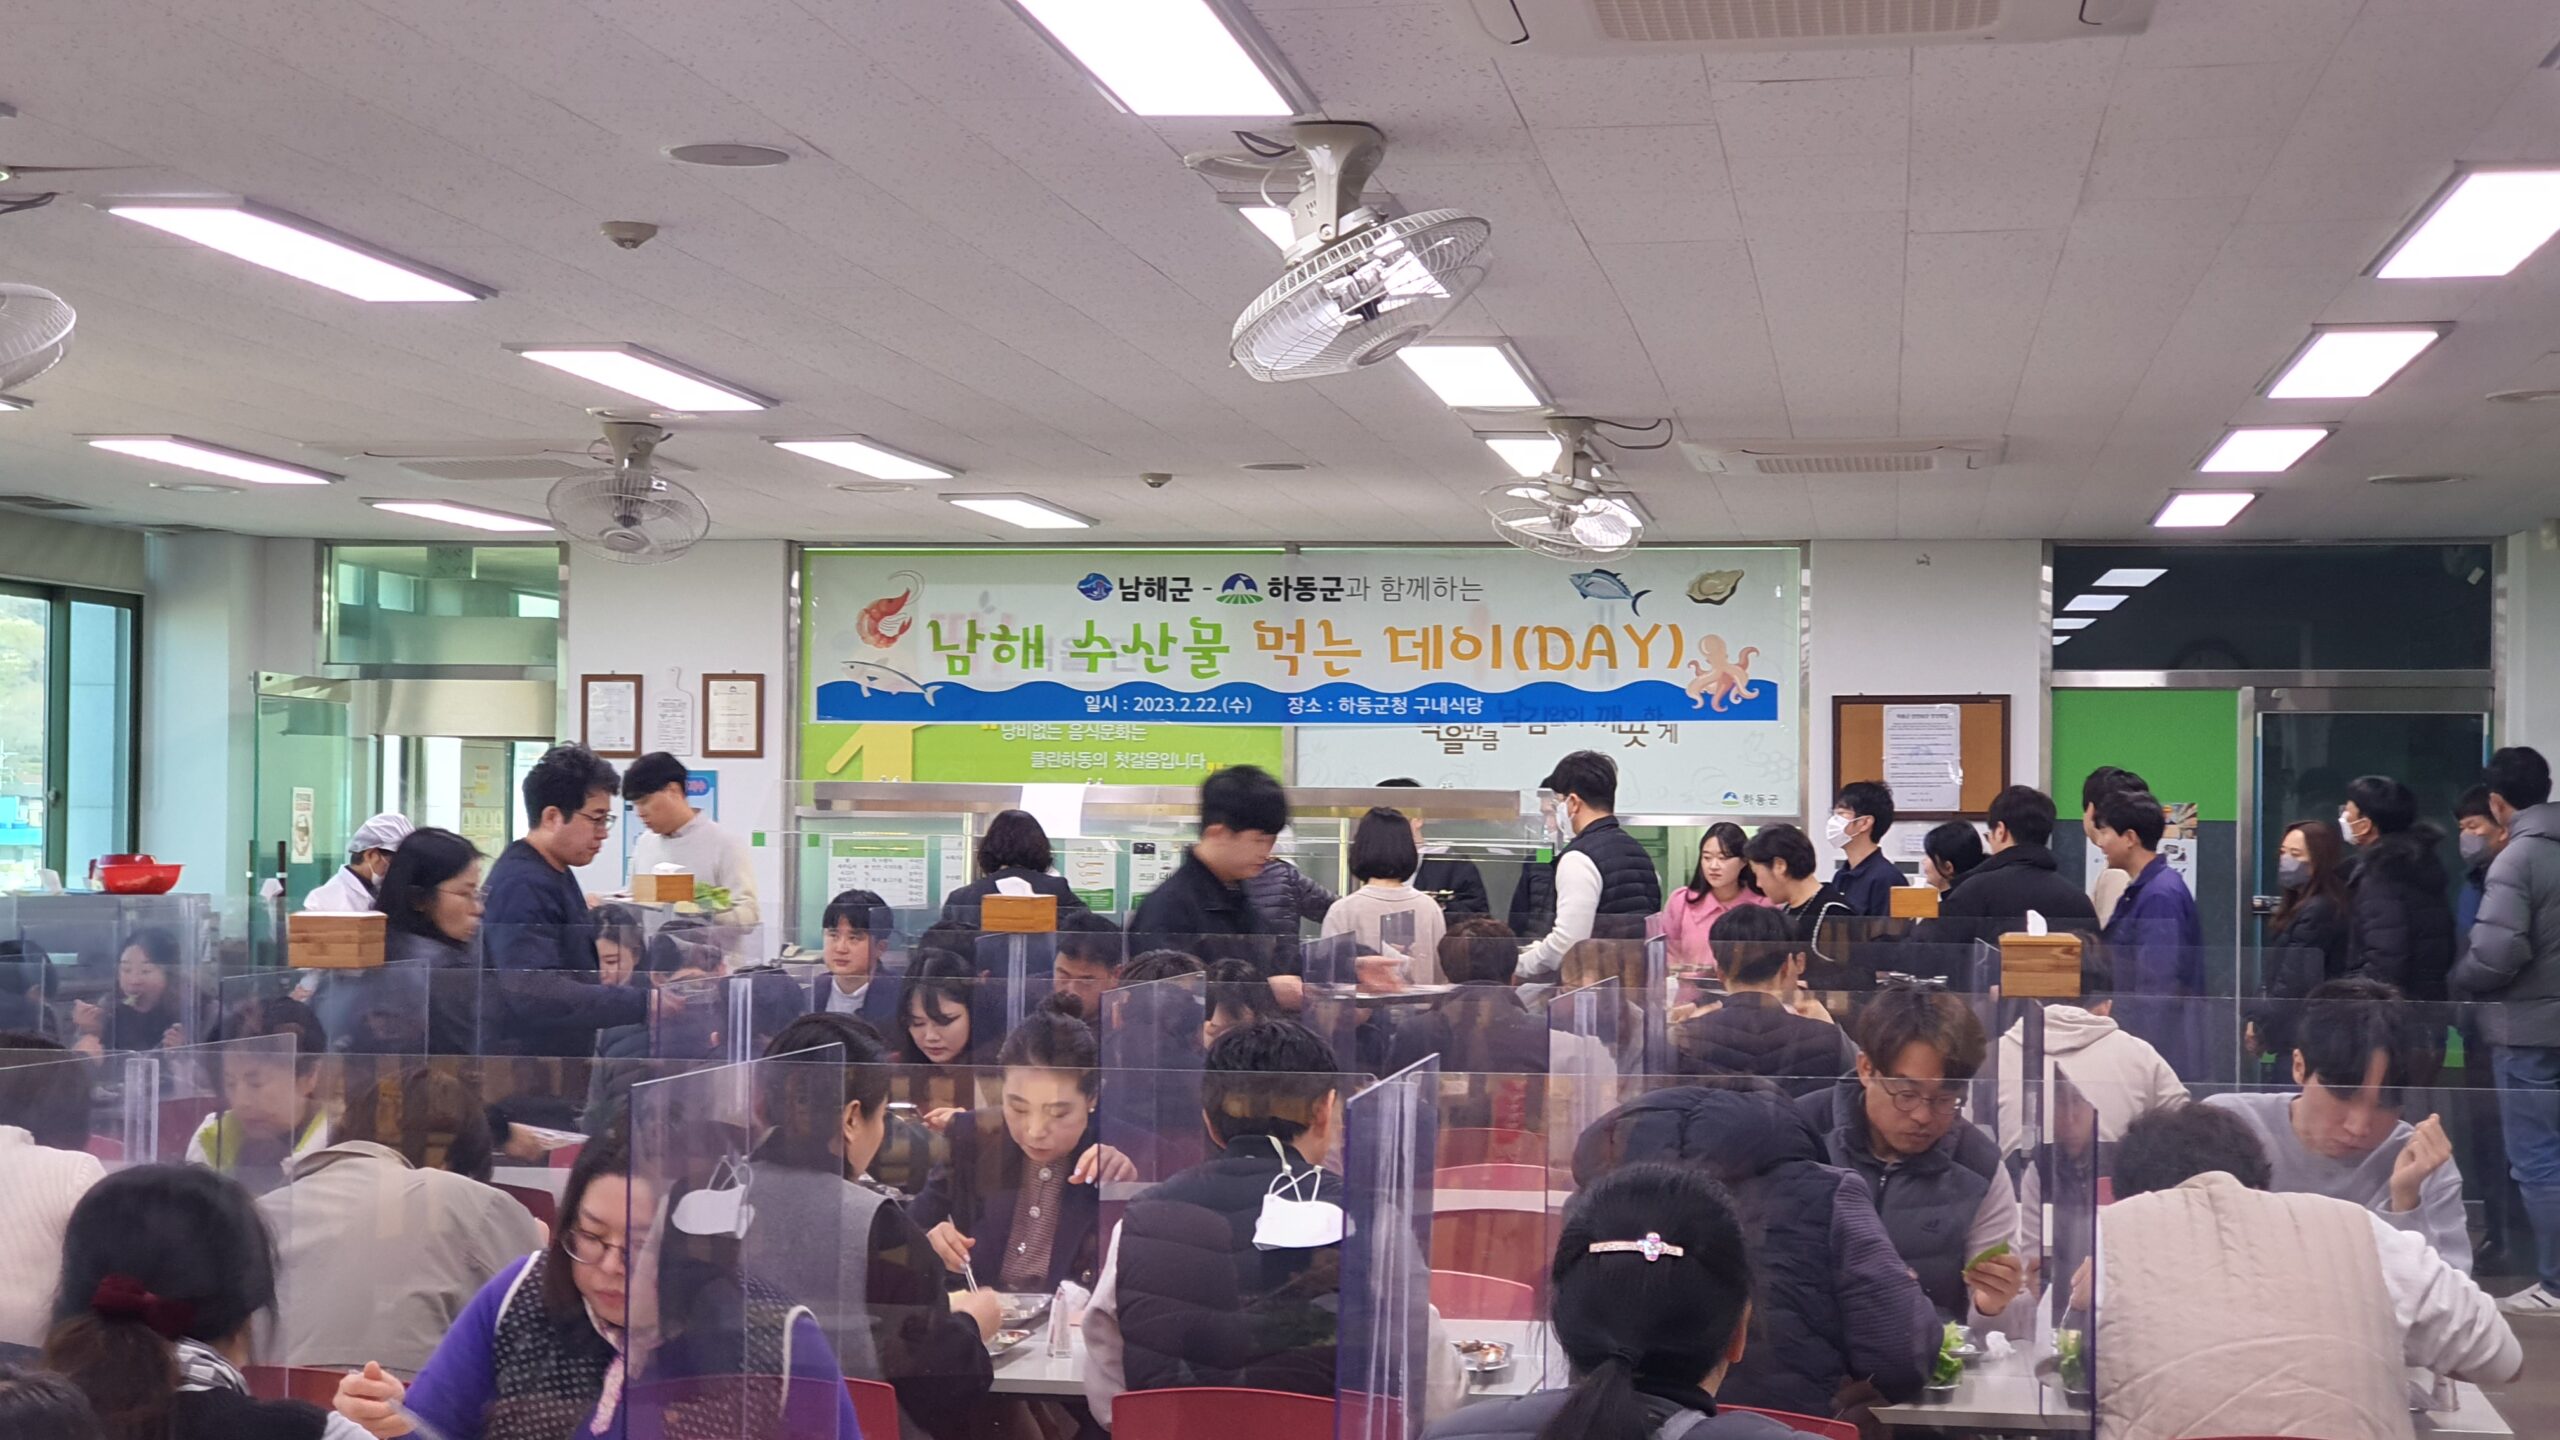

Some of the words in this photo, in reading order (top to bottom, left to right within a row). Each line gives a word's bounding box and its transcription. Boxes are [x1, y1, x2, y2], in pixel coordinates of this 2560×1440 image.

[1119, 576, 1193, 602] 남해군
[1267, 576, 1371, 602] 하동군과
[1380, 576, 1484, 603] 함께하는
[927, 618, 1045, 677] 남해
[1069, 616, 1231, 680] 수산물
[1253, 618, 1362, 677] 먹는
[1383, 623, 1684, 671] 데이(DAY)
[1084, 695, 1117, 713] 일시
[1133, 695, 1252, 714] 2023.2.22.(수)
[1287, 696, 1321, 714] 장소
[1338, 696, 1408, 714] 하동군청
[1413, 696, 1484, 714] 구내식당
[1068, 724, 1147, 741] 음식문화는
[1031, 751, 1108, 768] 클린하동의
[1114, 751, 1206, 769] 첫걸음입니다
